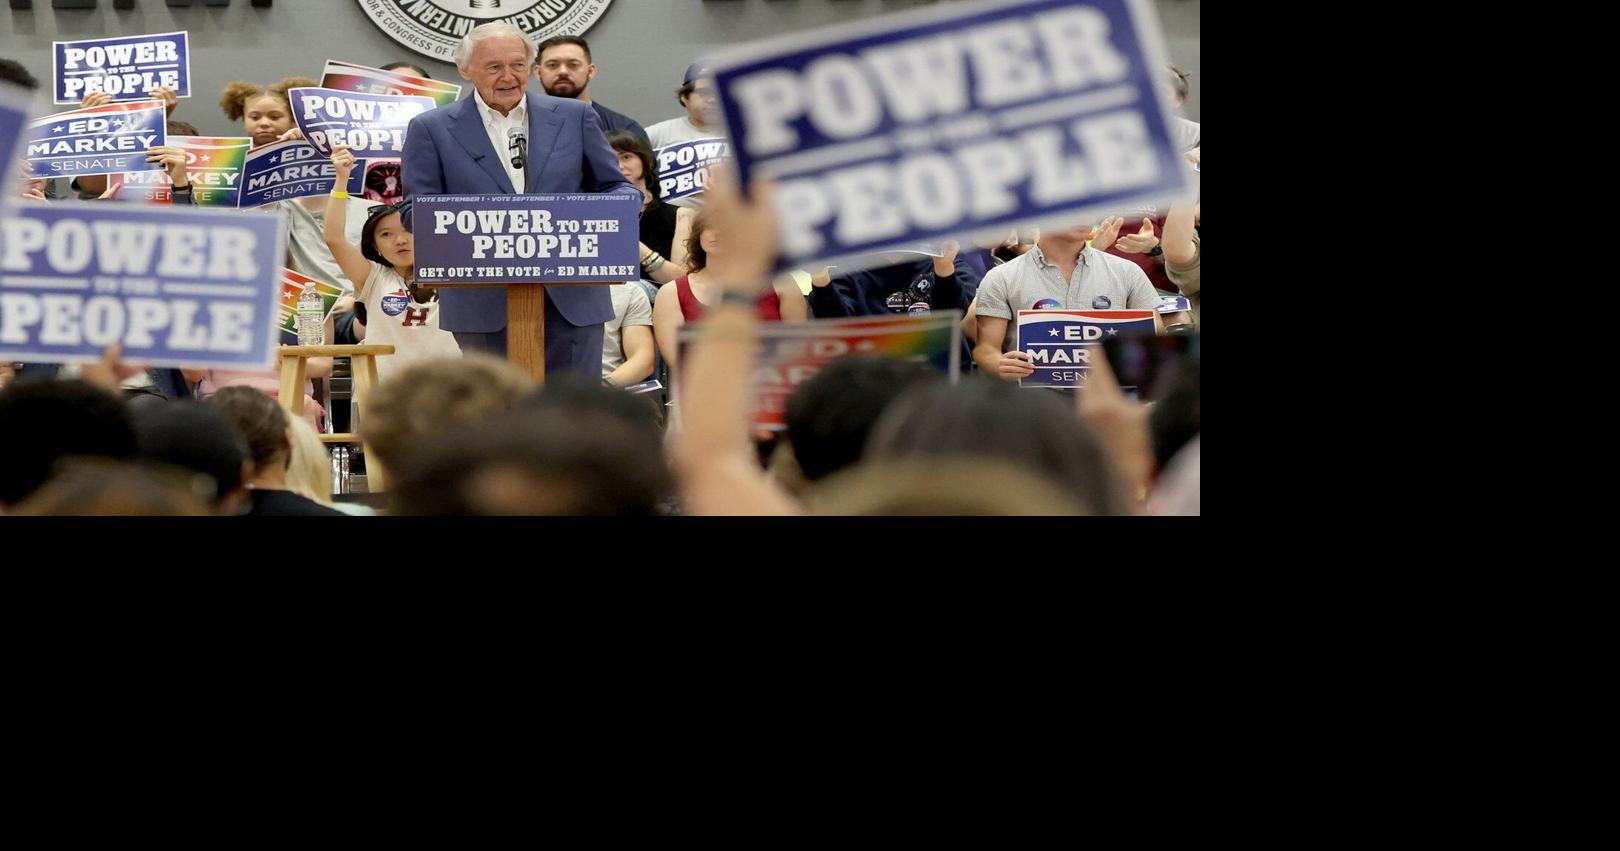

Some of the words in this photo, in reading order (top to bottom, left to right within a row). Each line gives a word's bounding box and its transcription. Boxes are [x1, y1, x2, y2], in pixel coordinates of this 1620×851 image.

[383, 17, 433, 51] CONGRESS
[434, 46, 449, 55] OF
[63, 40, 179, 69] POWER
[63, 71, 180, 98] PEOPLE
[729, 8, 1131, 156] POWER
[68, 118, 109, 135] ED
[27, 134, 159, 156] MARKEY
[308, 128, 406, 152] PEOPL
[51, 157, 128, 171] SENATE
[280, 147, 316, 163] ED
[123, 172, 240, 185] MAKEY
[248, 164, 359, 191] MARKE
[659, 168, 708, 198] PEO
[770, 110, 1160, 258] PEOPLE
[263, 182, 327, 200] SENATE
[433, 209, 554, 234] POWER
[556, 220, 580, 233] TO
[583, 219, 619, 232] THE
[0, 217, 259, 280] POWER
[472, 234, 599, 259] PEOPLE
[419, 267, 445, 278] GET
[447, 267, 474, 278] OUT
[476, 266, 503, 277] THE
[506, 266, 541, 277] VOTE
[544, 267, 555, 275] for
[557, 266, 575, 276] ED
[578, 265, 635, 276] MARKEY
[0, 293, 254, 353] PEOPLE
[402, 306, 429, 326] H
[1064, 325, 1103, 341] ED
[1026, 349, 1091, 364] MAR
[1052, 371, 1088, 381] SEN
